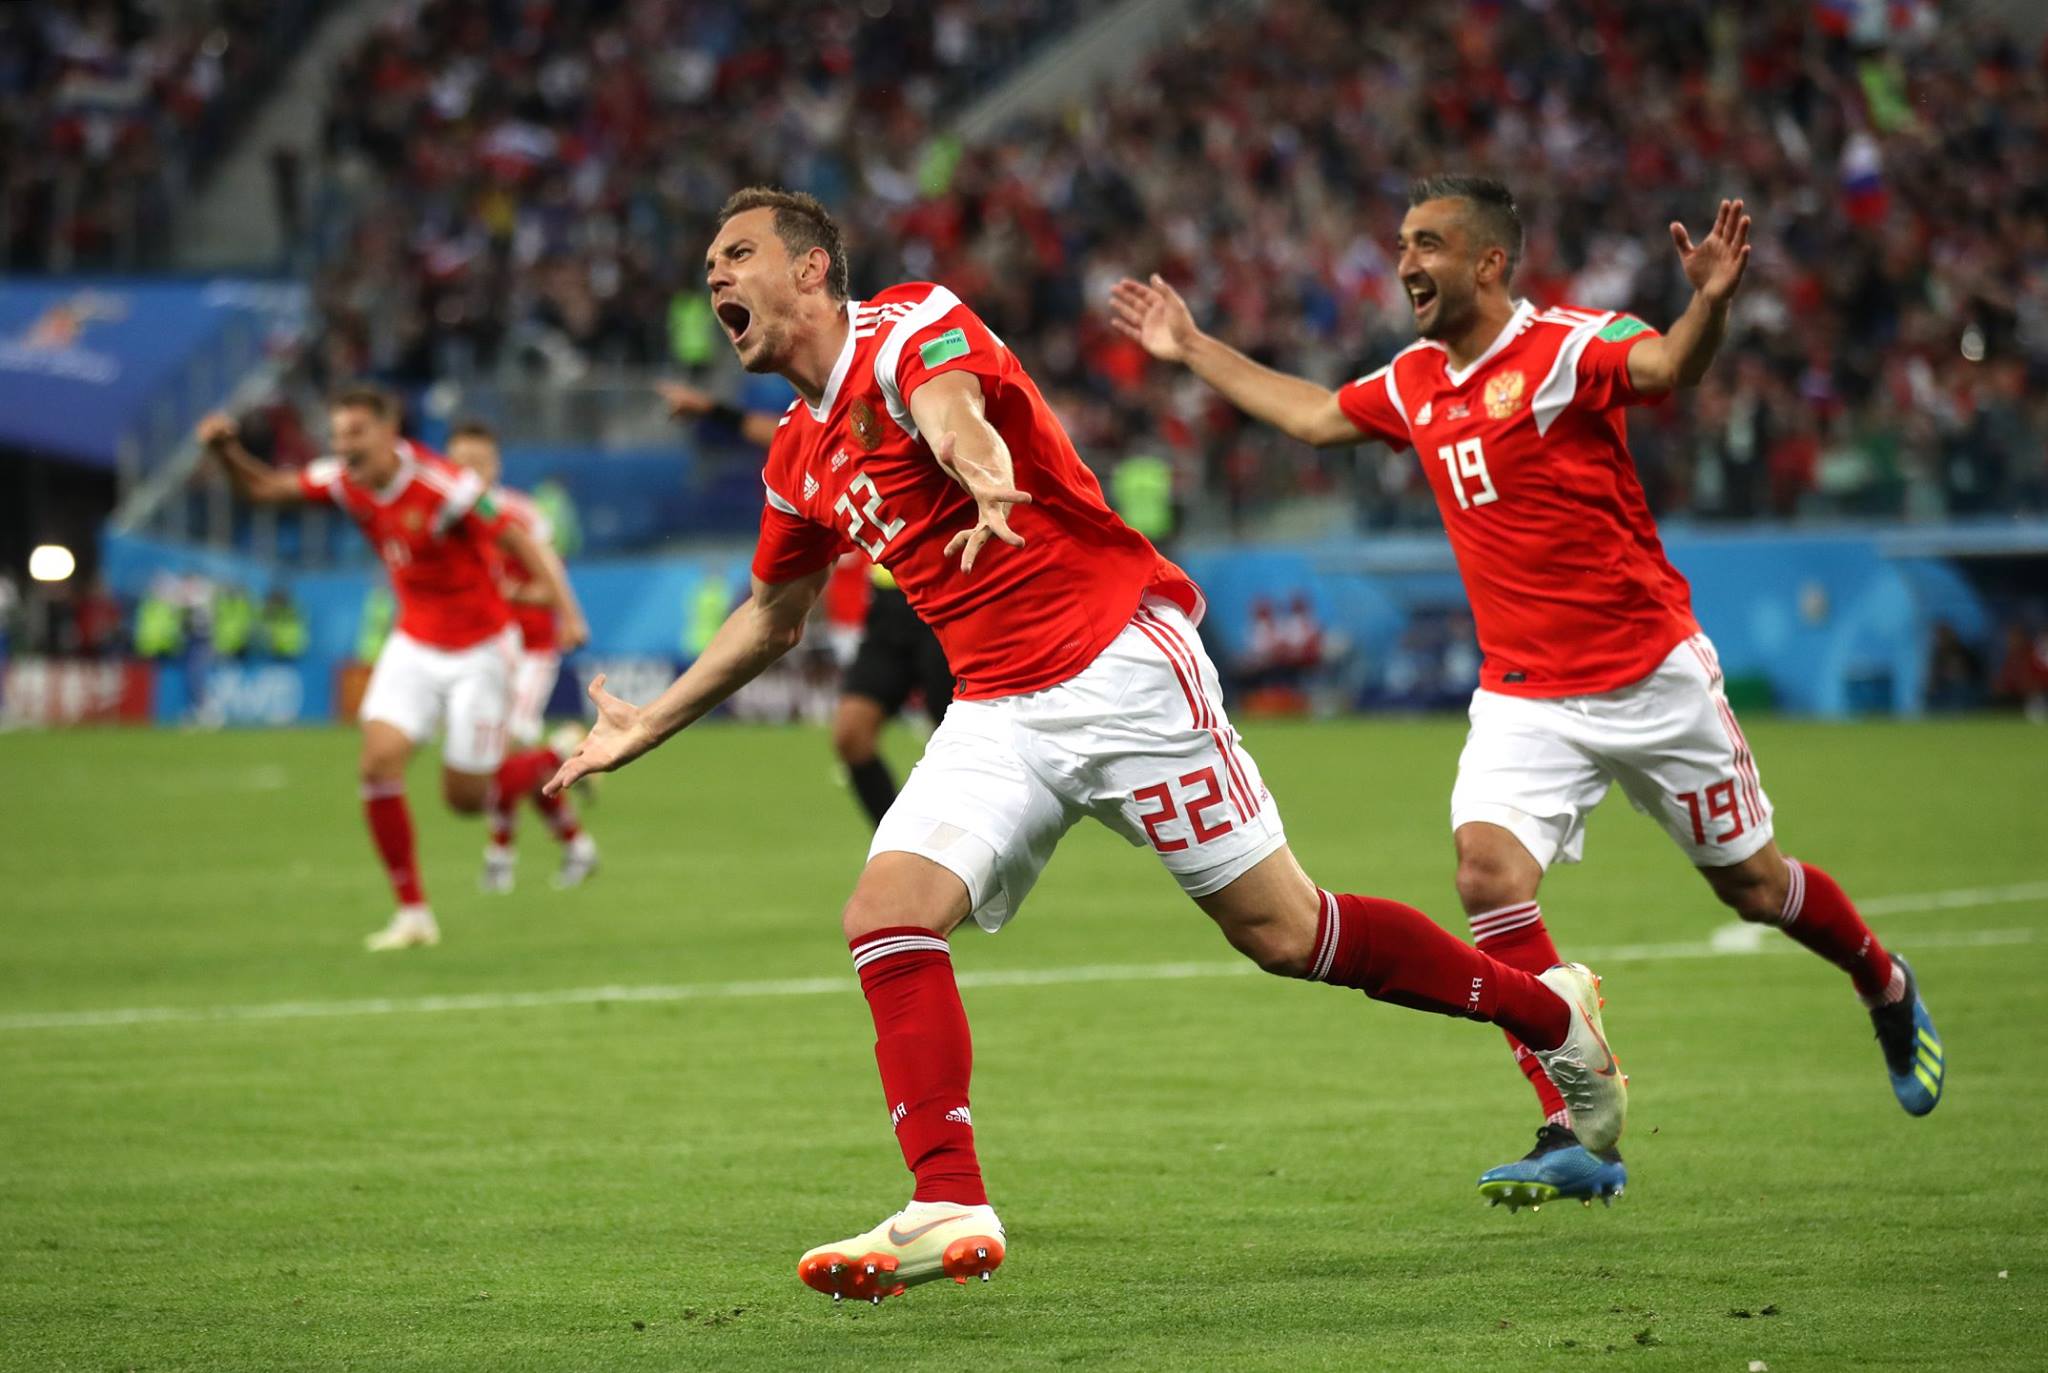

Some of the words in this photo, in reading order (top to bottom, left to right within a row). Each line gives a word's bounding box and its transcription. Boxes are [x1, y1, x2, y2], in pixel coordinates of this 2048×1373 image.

[1437, 436, 1499, 511] 19
[833, 471, 906, 562] 22
[1132, 765, 1234, 853] 22
[1676, 778, 1744, 846] 19
